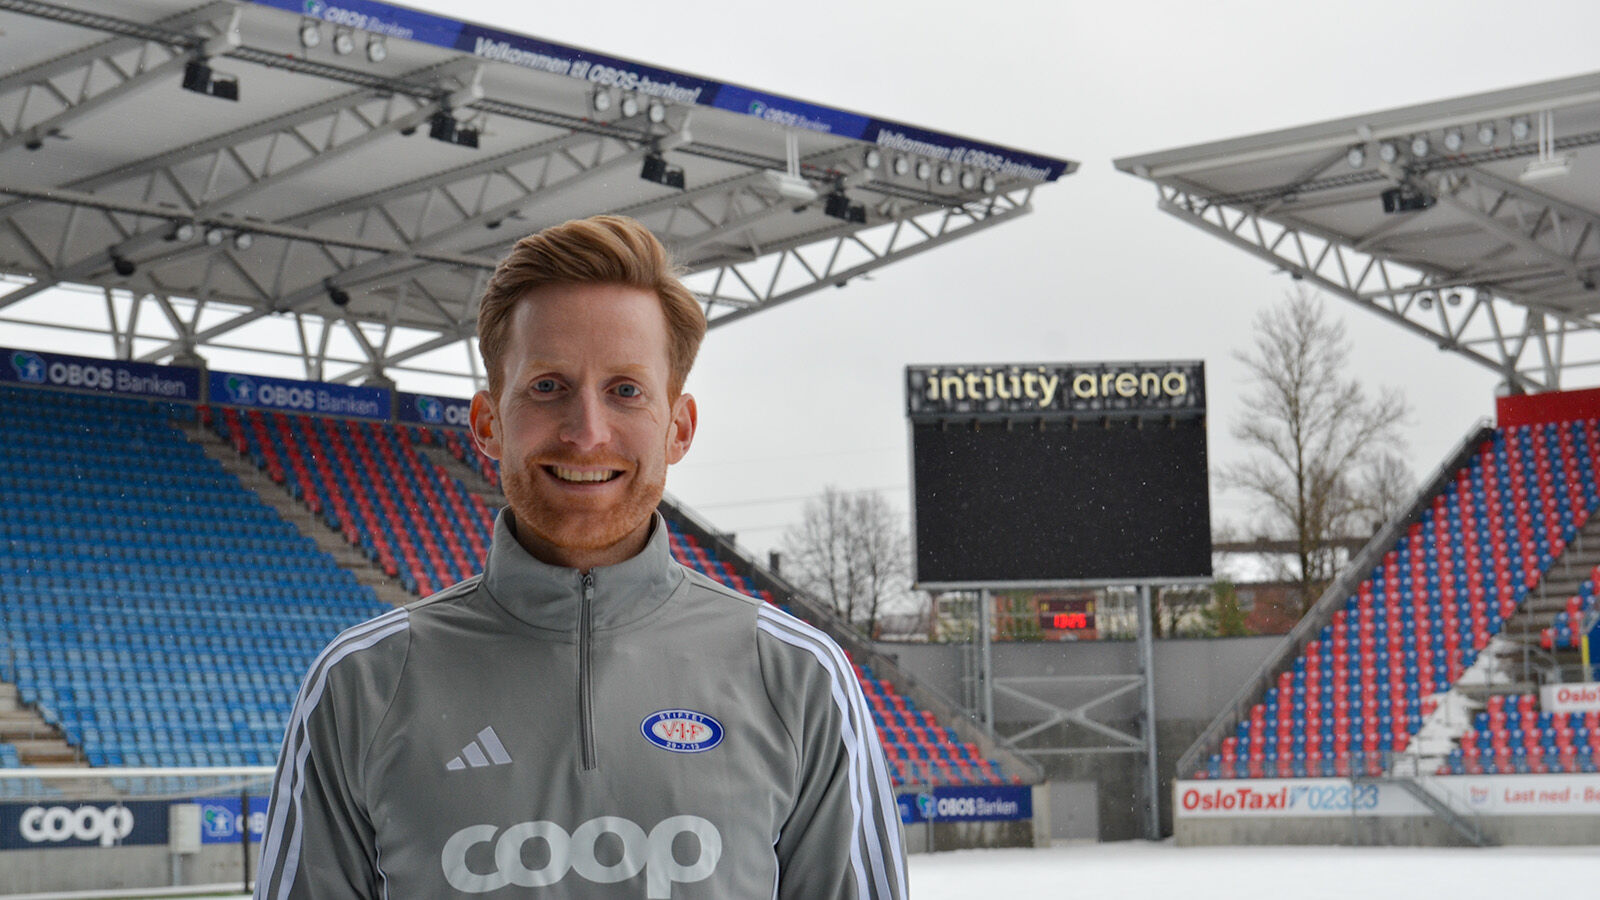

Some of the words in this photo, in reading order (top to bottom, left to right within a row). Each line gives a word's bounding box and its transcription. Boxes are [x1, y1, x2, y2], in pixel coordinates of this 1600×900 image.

[324, 7, 368, 28] OBOS
[367, 16, 414, 39] Banken
[475, 36, 569, 76] Velkommen
[571, 60, 592, 80] til
[588, 64, 702, 105] OBOS-banken!
[50, 362, 113, 389] OBOS
[115, 369, 187, 397] Banken
[928, 366, 1059, 407] intility
[1072, 370, 1188, 398] arena
[258, 384, 315, 409] OBOS
[316, 390, 379, 416] Banken
[659, 711, 704, 722] STIFTET
[938, 797, 976, 817] OBOS
[976, 796, 1018, 816] Banken
[1183, 786, 1288, 810] OsloTaxi
[1308, 784, 1380, 810] 02323
[1504, 786, 1535, 804] Last
[1539, 785, 1571, 804] ned
[20, 805, 134, 848] coop
[441, 814, 722, 899] coop
